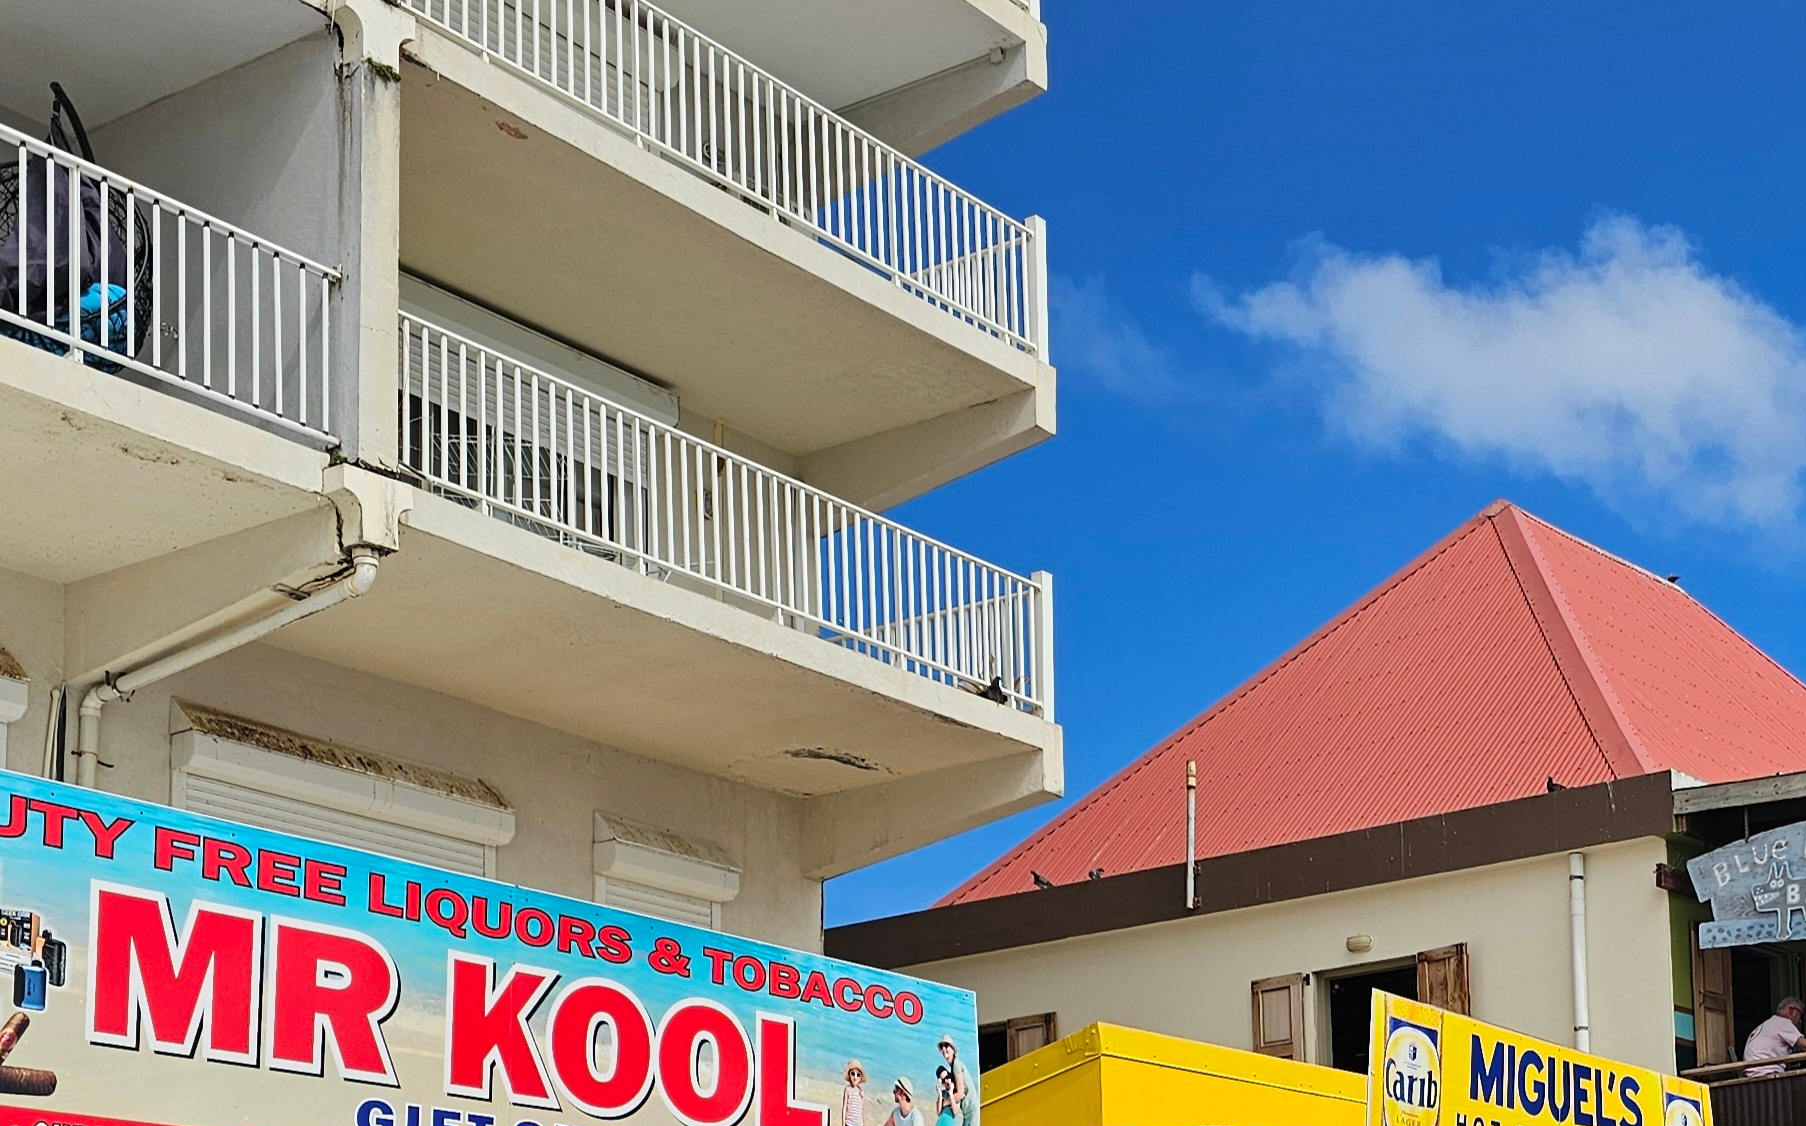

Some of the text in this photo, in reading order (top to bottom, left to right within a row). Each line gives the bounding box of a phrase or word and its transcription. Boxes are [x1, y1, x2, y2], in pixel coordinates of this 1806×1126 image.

[88, 882, 397, 1084] MR
[154, 826, 347, 907] FREE
[368, 872, 633, 965] LIQUORS
[648, 936, 691, 978] &
[702, 946, 924, 1025] TOBACCO
[1385, 1057, 1438, 1109] Carib
